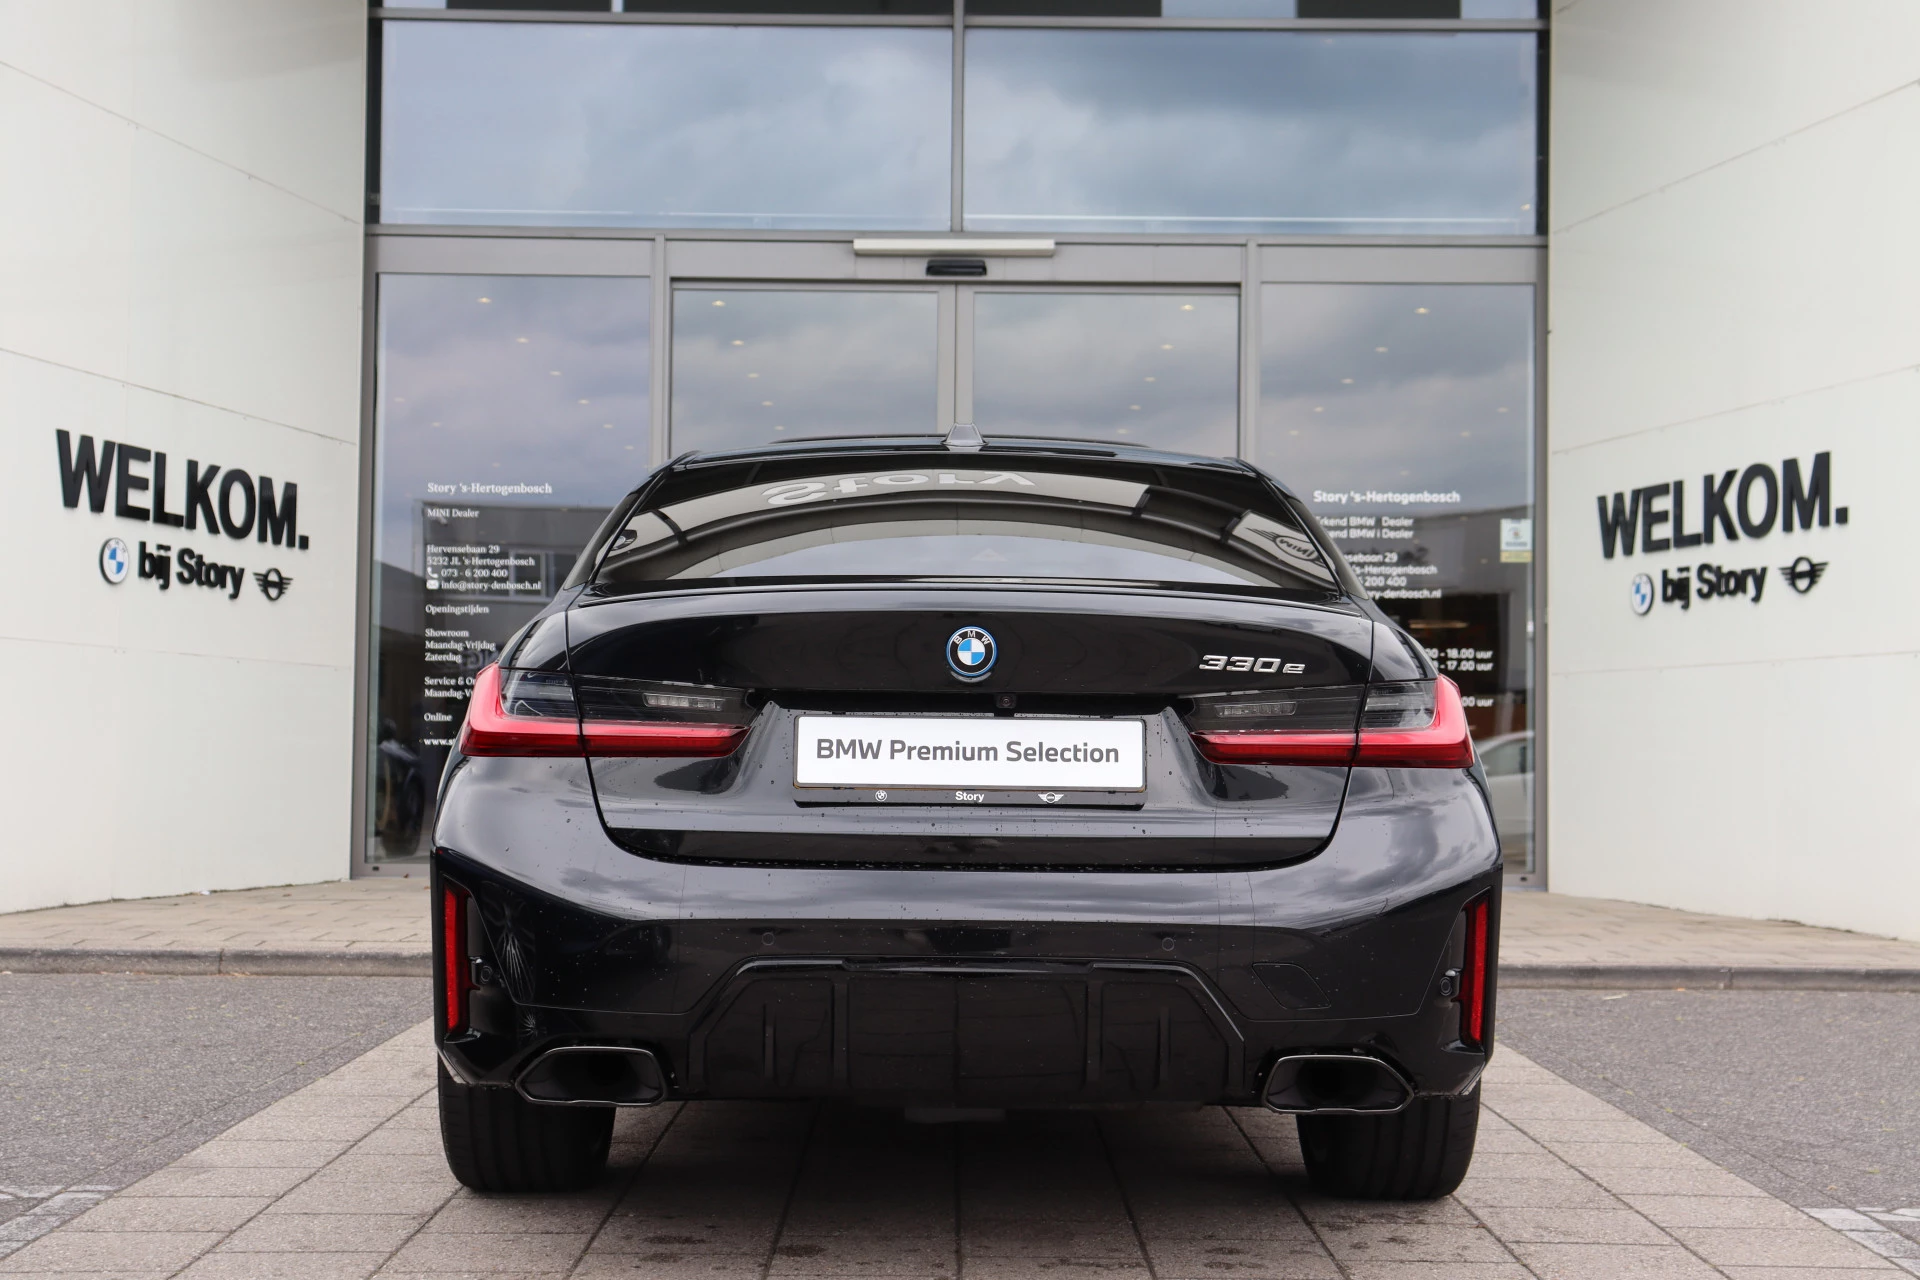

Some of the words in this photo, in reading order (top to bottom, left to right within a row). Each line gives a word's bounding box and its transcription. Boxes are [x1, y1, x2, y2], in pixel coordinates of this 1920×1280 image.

[56, 428, 309, 551] WELKOM.
[427, 482, 456, 496] Story
[1313, 490, 1347, 504] Story
[1597, 450, 1849, 560] WELKOM.
[427, 508, 450, 518] MINI
[452, 508, 480, 518] Dealer
[1349, 516, 1375, 526] BMW
[1382, 516, 1414, 526] Dealer
[1349, 529, 1375, 538] BMW
[1382, 528, 1414, 538] Dealer
[426, 544, 487, 554] Hervensebaan
[488, 544, 500, 554] 29
[426, 557, 448, 566] 5232
[1384, 552, 1398, 563] 29
[138, 541, 171, 591] bij
[176, 548, 245, 600] Story
[441, 568, 458, 577] 073
[465, 568, 472, 577] 6
[473, 568, 490, 577] 200
[491, 568, 508, 577] 400
[441, 581, 542, 591] info@story-denbosch.nl
[1364, 576, 1385, 587] 200
[1386, 576, 1407, 586] 400
[1662, 565, 1691, 610] bij
[1696, 563, 1768, 603] Story
[425, 604, 490, 615] Openingstijden
[425, 628, 469, 637] Showroom
[425, 641, 496, 651] Maandag-Vrijdag
[424, 652, 462, 663] Zaterdag
[1446, 647, 1475, 659] 18.00
[1476, 651, 1493, 659] uur
[1199, 654, 1306, 674] 330e
[1476, 663, 1494, 671] uur
[424, 677, 456, 685] Service
[1476, 698, 1494, 707] uur
[423, 712, 453, 721] Online
[816, 738, 882, 761] BMW
[889, 739, 998, 762] Premium
[1006, 740, 1120, 763] Selection
[955, 791, 985, 803] Story
